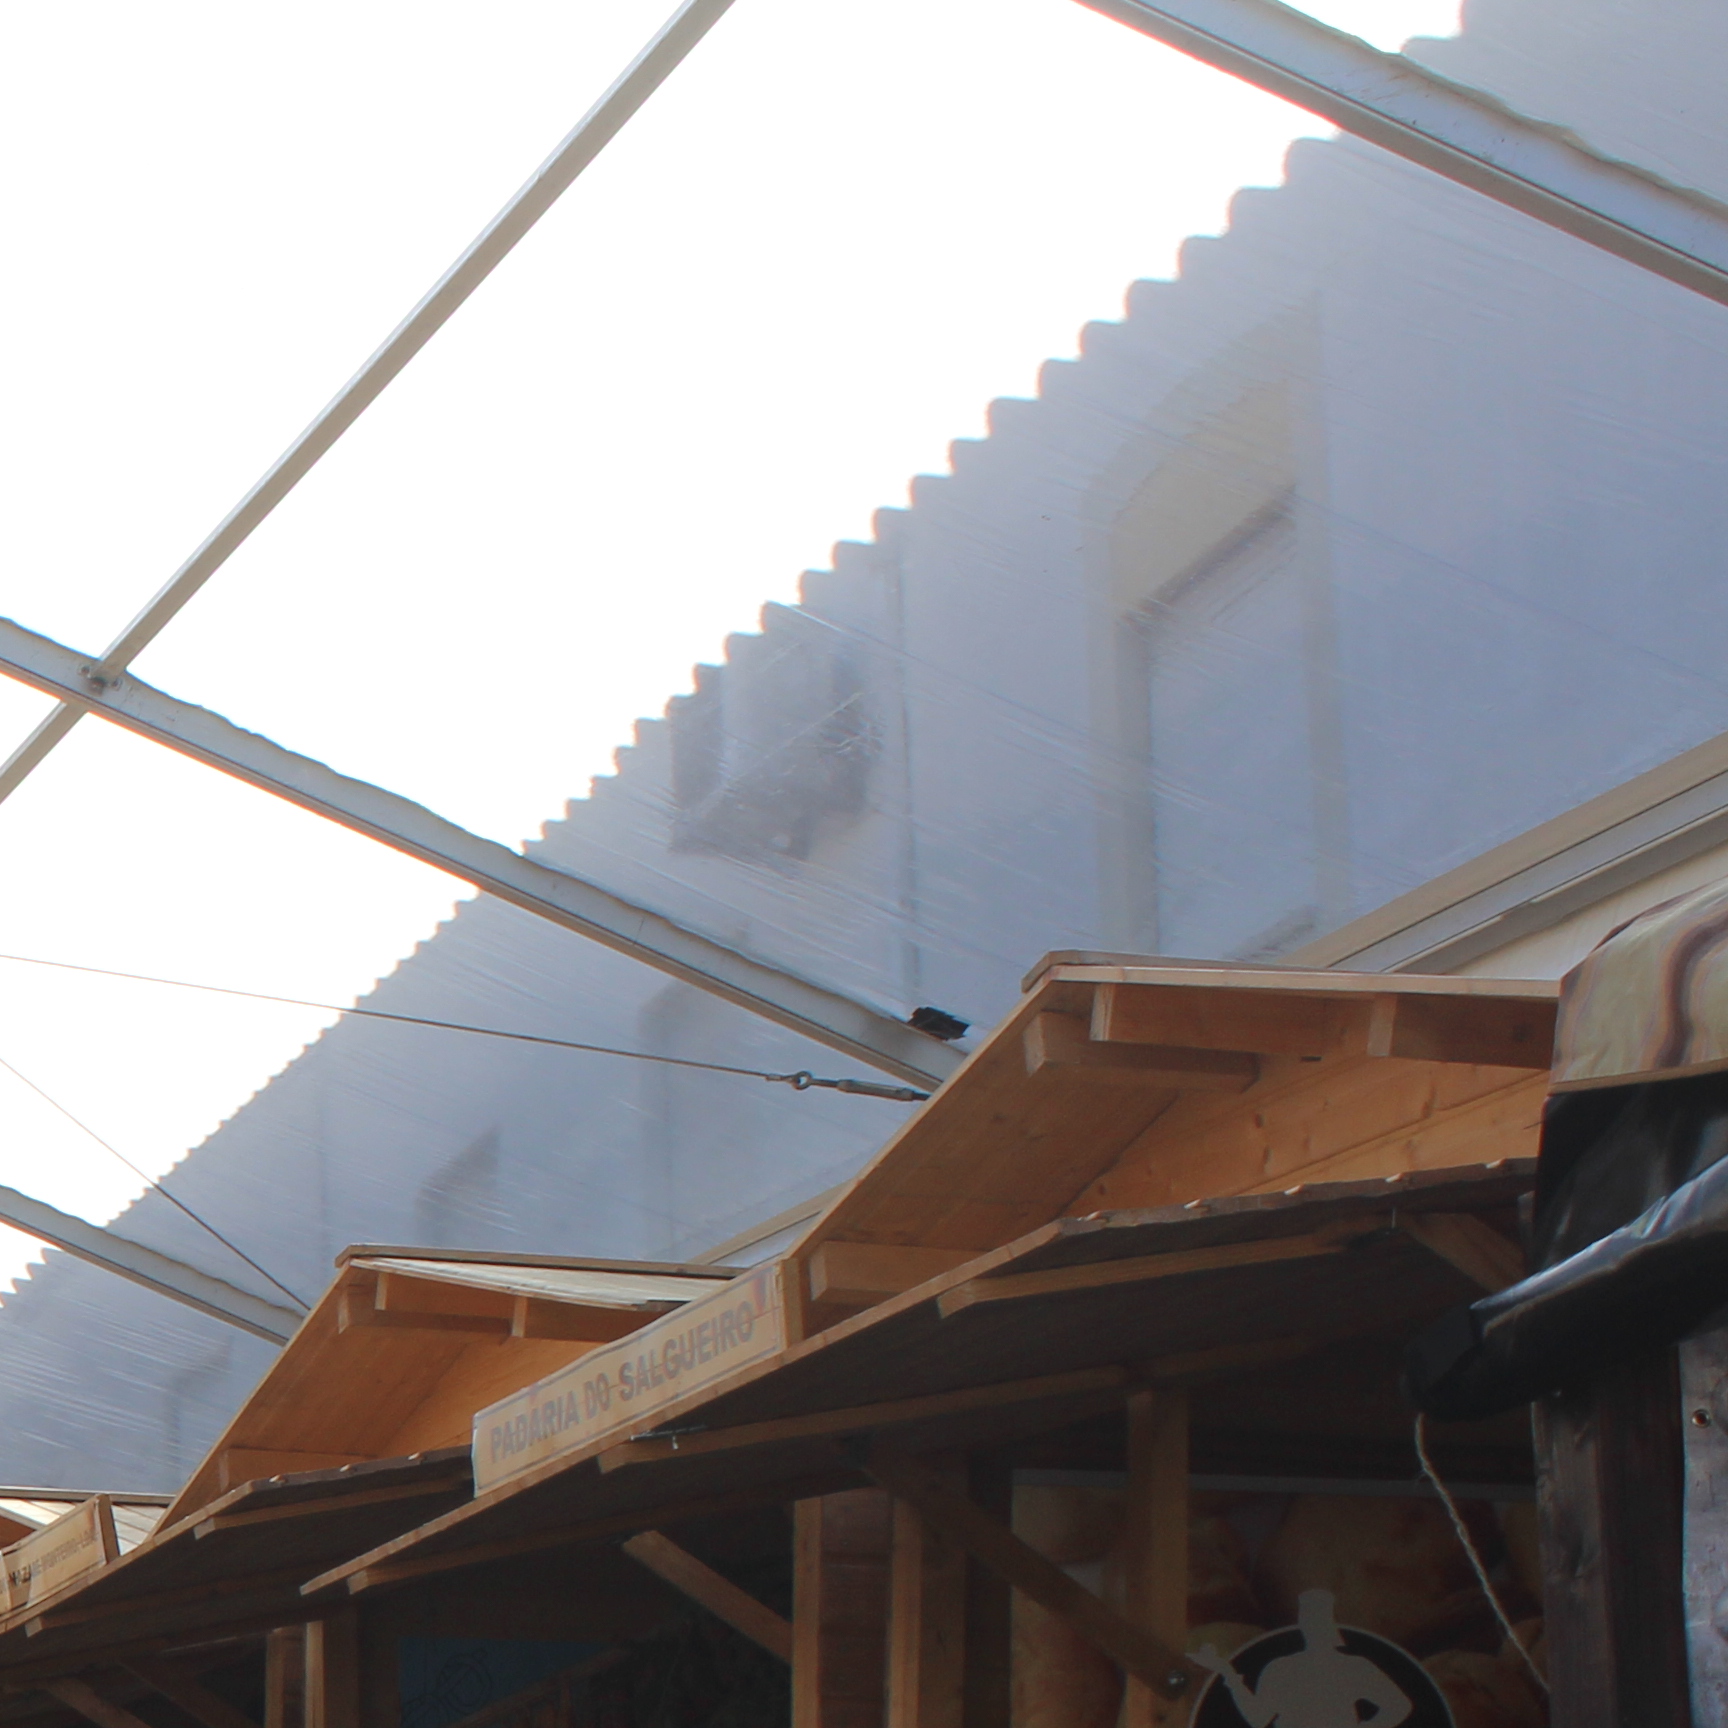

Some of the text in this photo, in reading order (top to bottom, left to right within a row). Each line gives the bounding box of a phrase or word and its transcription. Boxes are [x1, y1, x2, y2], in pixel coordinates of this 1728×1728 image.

[489, 1301, 754, 1462] PADARIA DO SALGUEIRO
